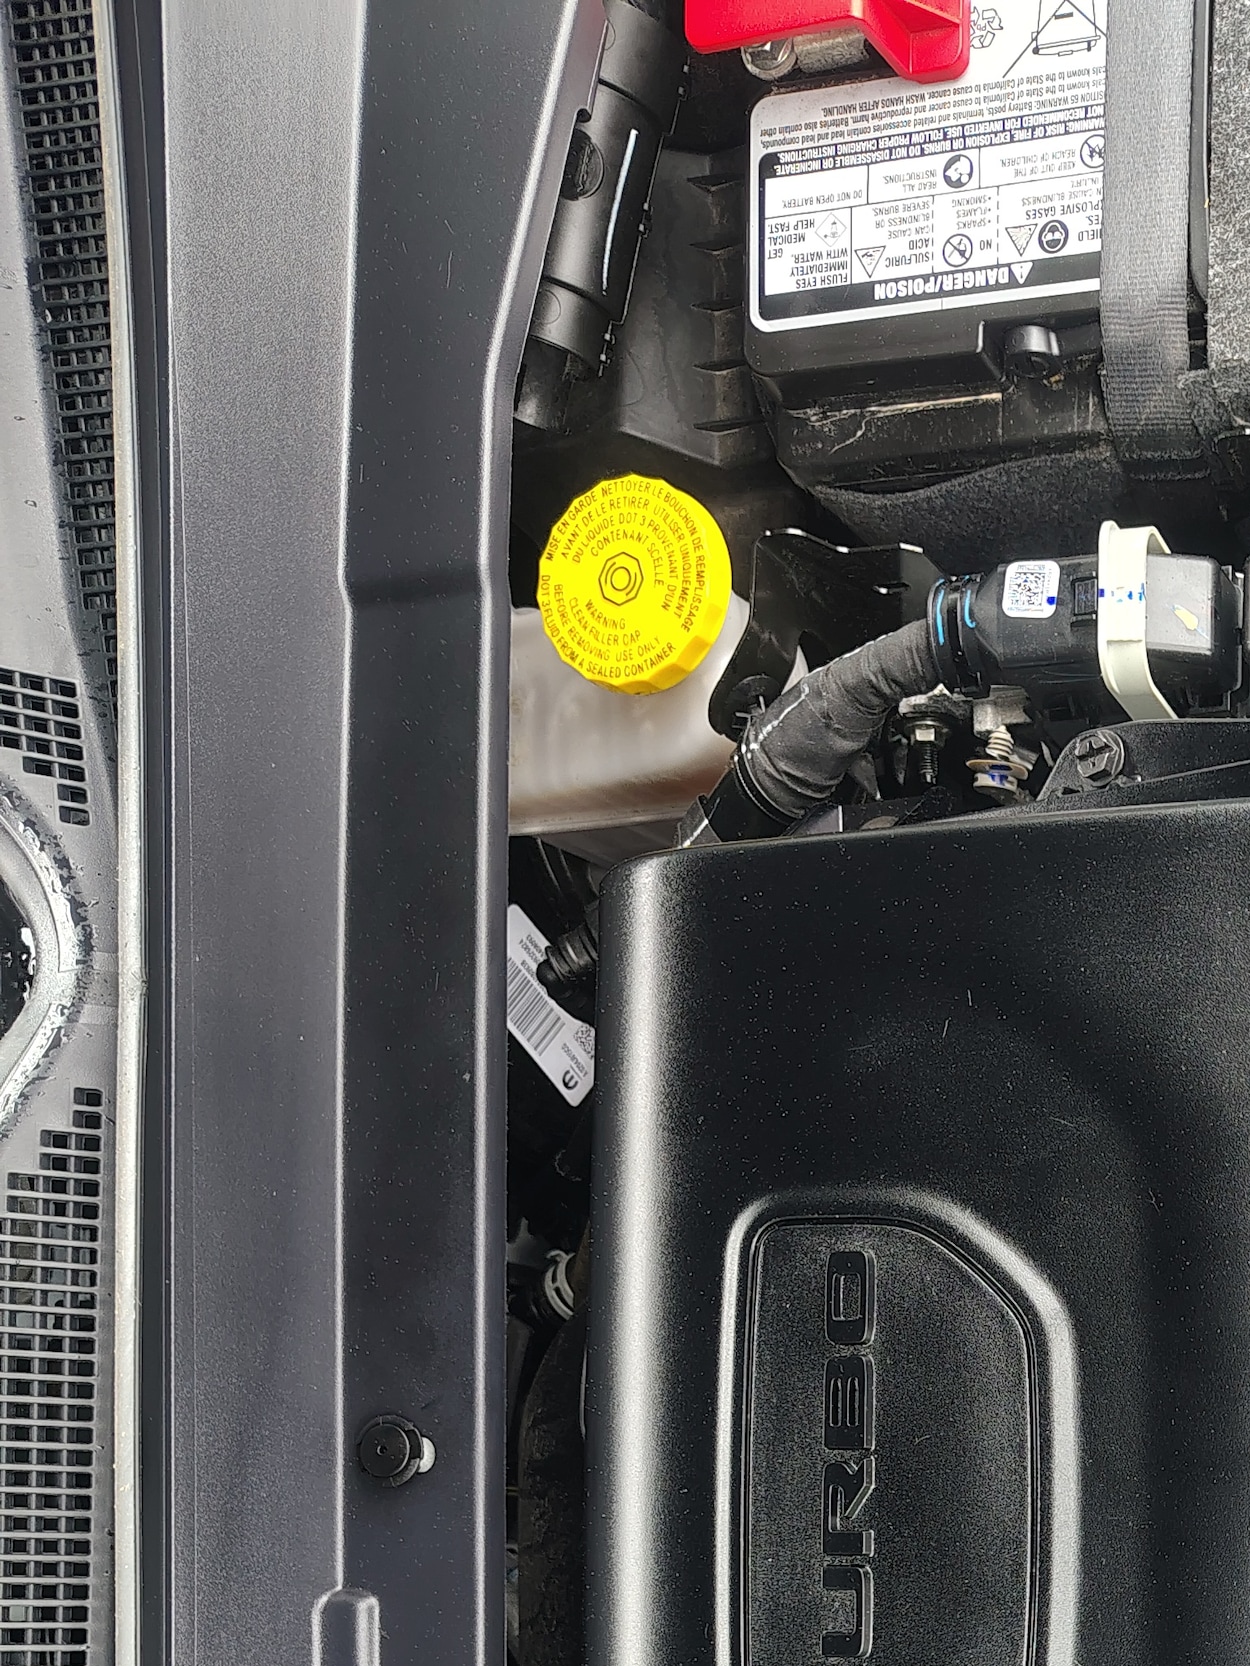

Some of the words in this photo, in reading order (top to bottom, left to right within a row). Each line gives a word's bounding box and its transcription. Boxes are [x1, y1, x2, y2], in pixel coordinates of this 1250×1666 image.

[1025, 87, 1043, 98] State
[1045, 85, 1055, 95] the
[1058, 84, 1064, 93] to
[1066, 79, 1089, 92] known
[881, 95, 903, 109] HANDS
[905, 92, 925, 105] WASH
[983, 91, 1015, 105] California
[1017, 90, 1023, 100] of
[1070, 94, 1078, 104] 65
[821, 102, 856, 117] HANDLING.
[858, 99, 879, 112] AFTER
[928, 101, 950, 113] cancer
[952, 98, 972, 109] cause
[1008, 99, 1032, 114] Battery
[1033, 96, 1068, 110] WARNING:
[871, 105, 912, 122] reproductive
[913, 105, 926, 116] and
[952, 108, 983, 122] terminals
[986, 104, 1005, 117] posts,
[1022, 106, 1085, 127] RECOMMENDED
[1086, 104, 1103, 118] NOT
[819, 116, 848, 130] Batteries
[851, 113, 869, 125] harm.
[913, 115, 936, 128] related
[938, 113, 950, 124] and
[1004, 116, 1020, 129] FOR
[760, 127, 776, 139] other
[778, 123, 801, 136] contain
[803, 121, 817, 133] also
[846, 125, 870, 138] contain
[872, 119, 911, 134] accessories
[963, 119, 1003, 136] INVERTED
[1010, 126, 1030, 141] FIRE,
[1032, 125, 1044, 138] OF
[1045, 122, 1064, 136] RISK
[760, 134, 799, 150] compounds,
[801, 134, 815, 145] lead
[816, 132, 828, 142] and
[830, 130, 844, 140] lead
[878, 133, 909, 149] PROPER
[910, 128, 943, 144] FOLLOW
[965, 130, 1009, 148] EXPLOSION
[836, 138, 877, 155] CHARGING
[908, 144, 920, 156] DO
[921, 140, 950, 154] BURNS.
[952, 137, 963, 150] OR
[777, 145, 835, 163] INSTRUCTIONS.
[834, 149, 889, 167] DISASSEMBLE
[890, 146, 907, 159] NOT
[773, 159, 820, 175] INCINERATE.
[821, 157, 833, 169] OR
[882, 168, 936, 184] INSTRUCTIONS.
[902, 182, 914, 193] ALL
[917, 180, 936, 191] READ
[815, 193, 834, 204] OPEN
[836, 190, 850, 201] NOT
[853, 189, 862, 199] DO
[1021, 191, 1063, 206] BLINDNESS
[871, 204, 899, 217] BURNS.
[902, 200, 929, 213] SEVERE
[1025, 205, 1055, 220] GASES
[792, 217, 814, 230] HELP
[875, 218, 885, 229] OR
[887, 212, 929, 227] BLINDNESS
[767, 221, 789, 234] FAST.
[887, 227, 910, 239] CAUSE
[914, 224, 929, 236] CAN
[767, 231, 805, 246] MEDICAL
[908, 236, 929, 250] ACID
[979, 238, 991, 250] NO
[767, 247, 782, 259] GET
[791, 249, 822, 264] WATER.
[826, 247, 847, 259] WITH
[885, 251, 929, 267] SULFURIC
[789, 259, 847, 277] IMMEDIATELY
[795, 276, 816, 289] EYES
[820, 272, 847, 286] FLUSH
[874, 265, 1008, 300] DANGER/POISON
[601, 479, 651, 497] NETTOYER
[652, 484, 663, 497] LE
[568, 490, 597, 519] GARDE
[663, 491, 697, 537] BOUCHON
[558, 520, 570, 534] EN
[547, 535, 561, 562] MISE
[572, 549, 584, 564] DU
[583, 515, 615, 549] LIQUIDE
[618, 512, 637, 524] DOT
[639, 515, 647, 527] 3
[647, 520, 678, 581] PROVENANT
[693, 537, 703, 553] DE
[561, 526, 583, 559] AVANT
[582, 513, 594, 528] DE
[596, 504, 606, 517] LE
[609, 496, 650, 510] RETIRER
[654, 505, 685, 543] UTILISER
[674, 542, 692, 619] UNIQUEMENT
[590, 528, 649, 557] CONTENANT
[647, 543, 664, 588] SCELLE
[540, 574, 551, 597] DOT
[681, 555, 706, 633] REMPLISSAGE
[585, 599, 626, 630] WARNING
[543, 608, 561, 638] FLUID
[554, 584, 570, 627] BEFORE
[567, 627, 610, 662] REMOVING
[615, 649, 633, 662] USE
[637, 636, 661, 656] ONLY
[569, 597, 589, 631] CLEAN
[588, 629, 619, 647] FILLER
[622, 629, 641, 645] CAP
[556, 634, 578, 661] FROM
[578, 659, 584, 668] A
[624, 642, 676, 676] CONTAINER
[586, 661, 621, 678] SEALED
